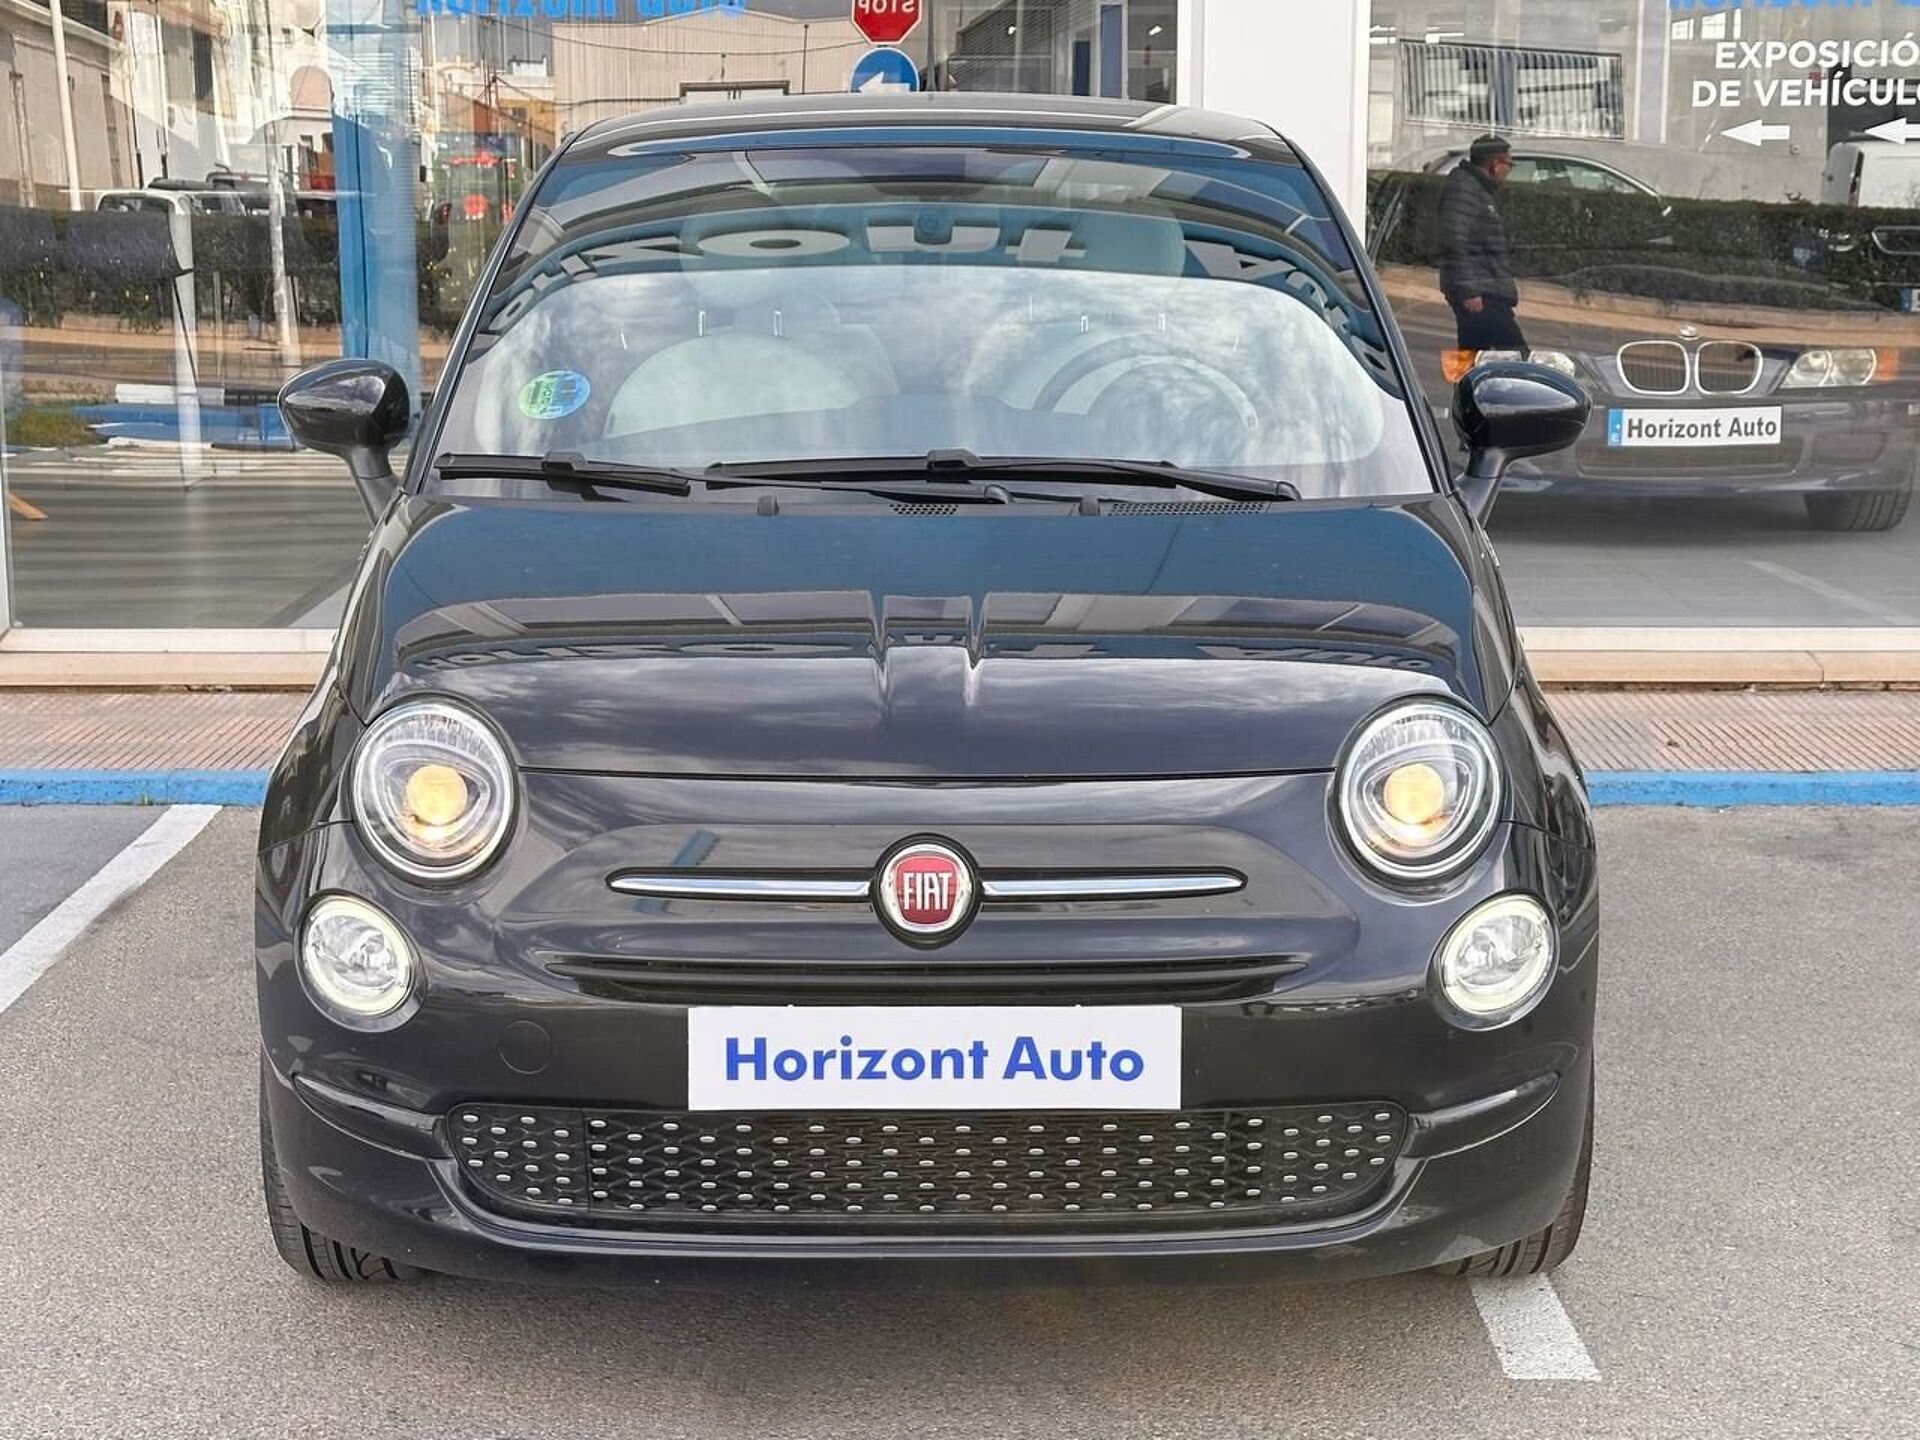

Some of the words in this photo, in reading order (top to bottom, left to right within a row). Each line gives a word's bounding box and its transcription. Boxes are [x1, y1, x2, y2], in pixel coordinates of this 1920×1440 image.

[1715, 32, 1919, 69] EXPOSICIÓ
[1692, 80, 1741, 107] DE
[1753, 71, 1920, 107] VEHÍCUL
[1627, 418, 1721, 439] Horizont
[1728, 417, 1777, 437] Auto
[903, 872, 953, 910] FIAT
[725, 1035, 989, 1081] Horizont
[1002, 1036, 1145, 1082] Auto
